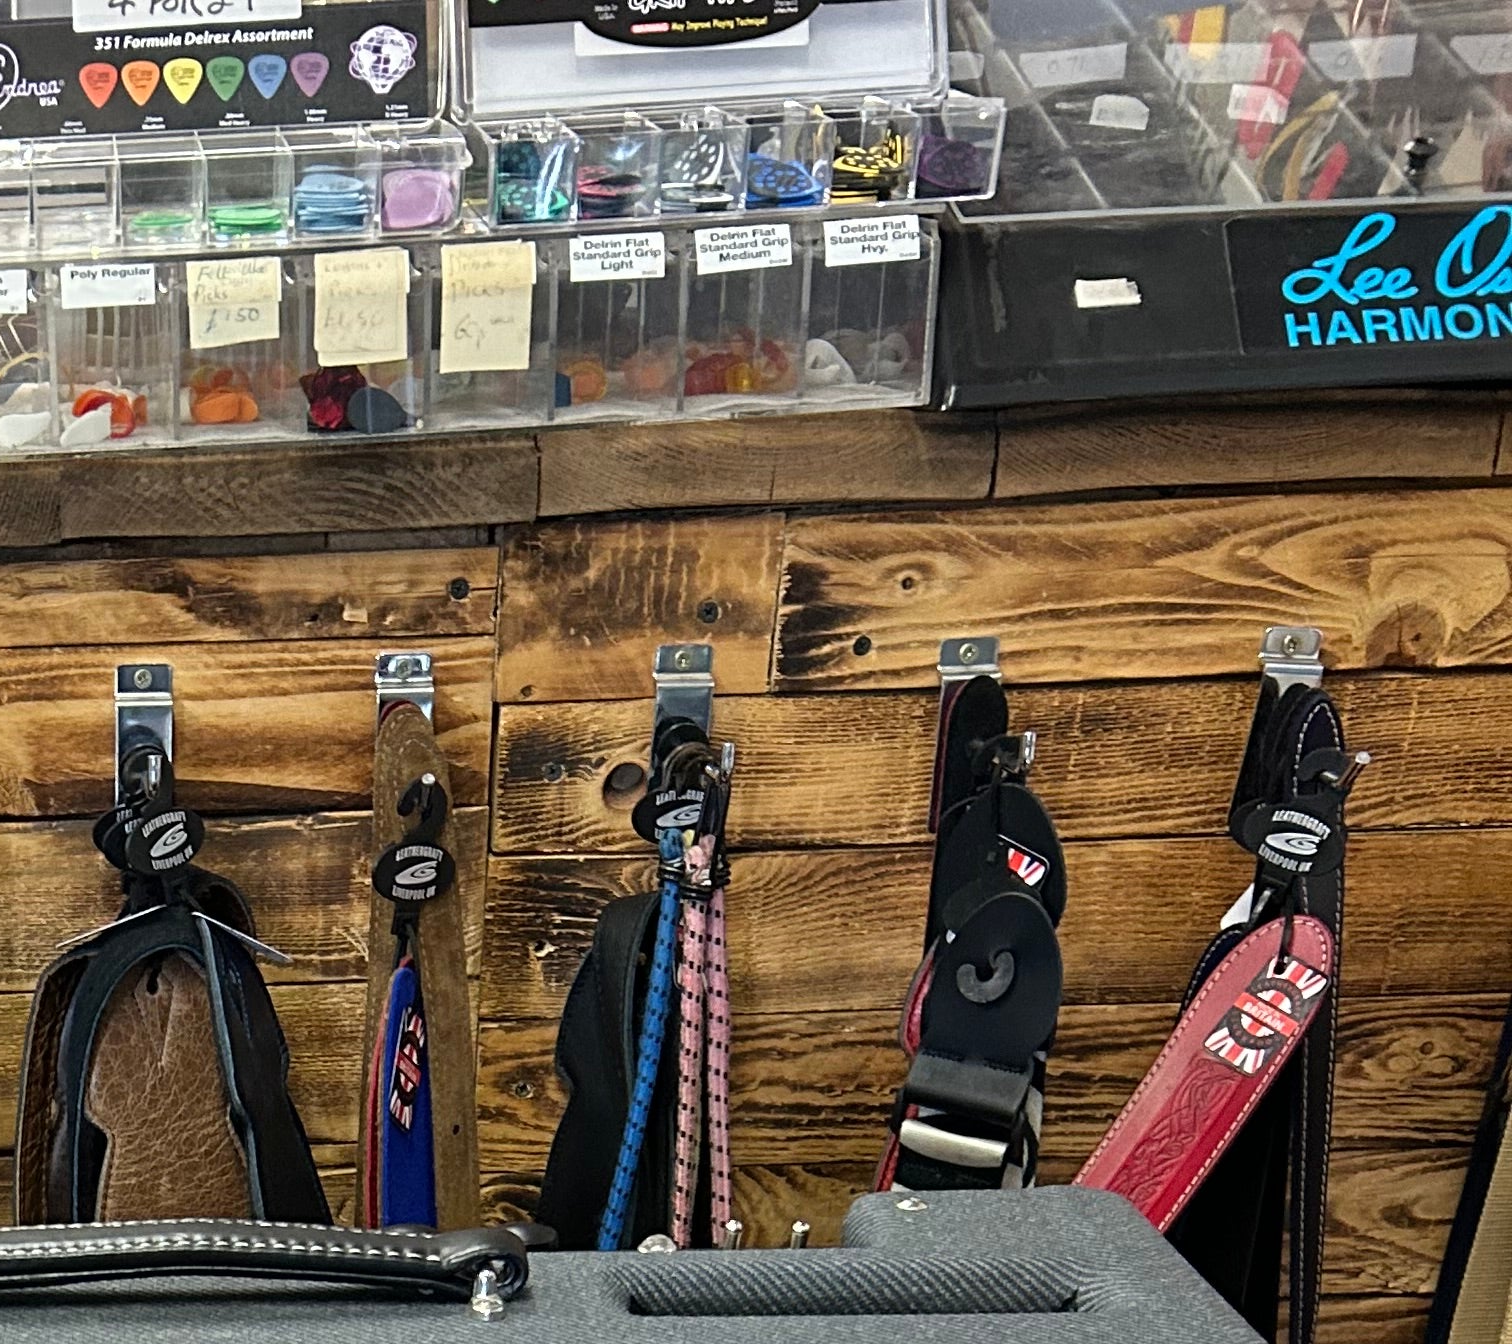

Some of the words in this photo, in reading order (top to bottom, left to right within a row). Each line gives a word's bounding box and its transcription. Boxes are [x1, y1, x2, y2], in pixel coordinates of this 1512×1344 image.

[94, 36, 120, 50] 351
[124, 33, 181, 49] Formula
[231, 27, 314, 43] Assortment
[840, 223, 879, 234] Delrin
[883, 221, 907, 231] Flat
[710, 232, 748, 242] Delrin
[752, 228, 776, 238] Flat
[830, 233, 888, 245] Standard
[892, 230, 920, 241] Grip
[584, 240, 621, 250] Delrin
[625, 238, 650, 248] Flat
[699, 240, 758, 254] Standard
[762, 237, 789, 249] Grip
[573, 250, 630, 261] Standard
[635, 248, 662, 260] Grip
[718, 249, 772, 263] Medium
[1281, 211, 1420, 306] Lee
[600, 260, 634, 271] Light
[70, 270, 97, 281] Poly
[101, 267, 151, 279] Regular
